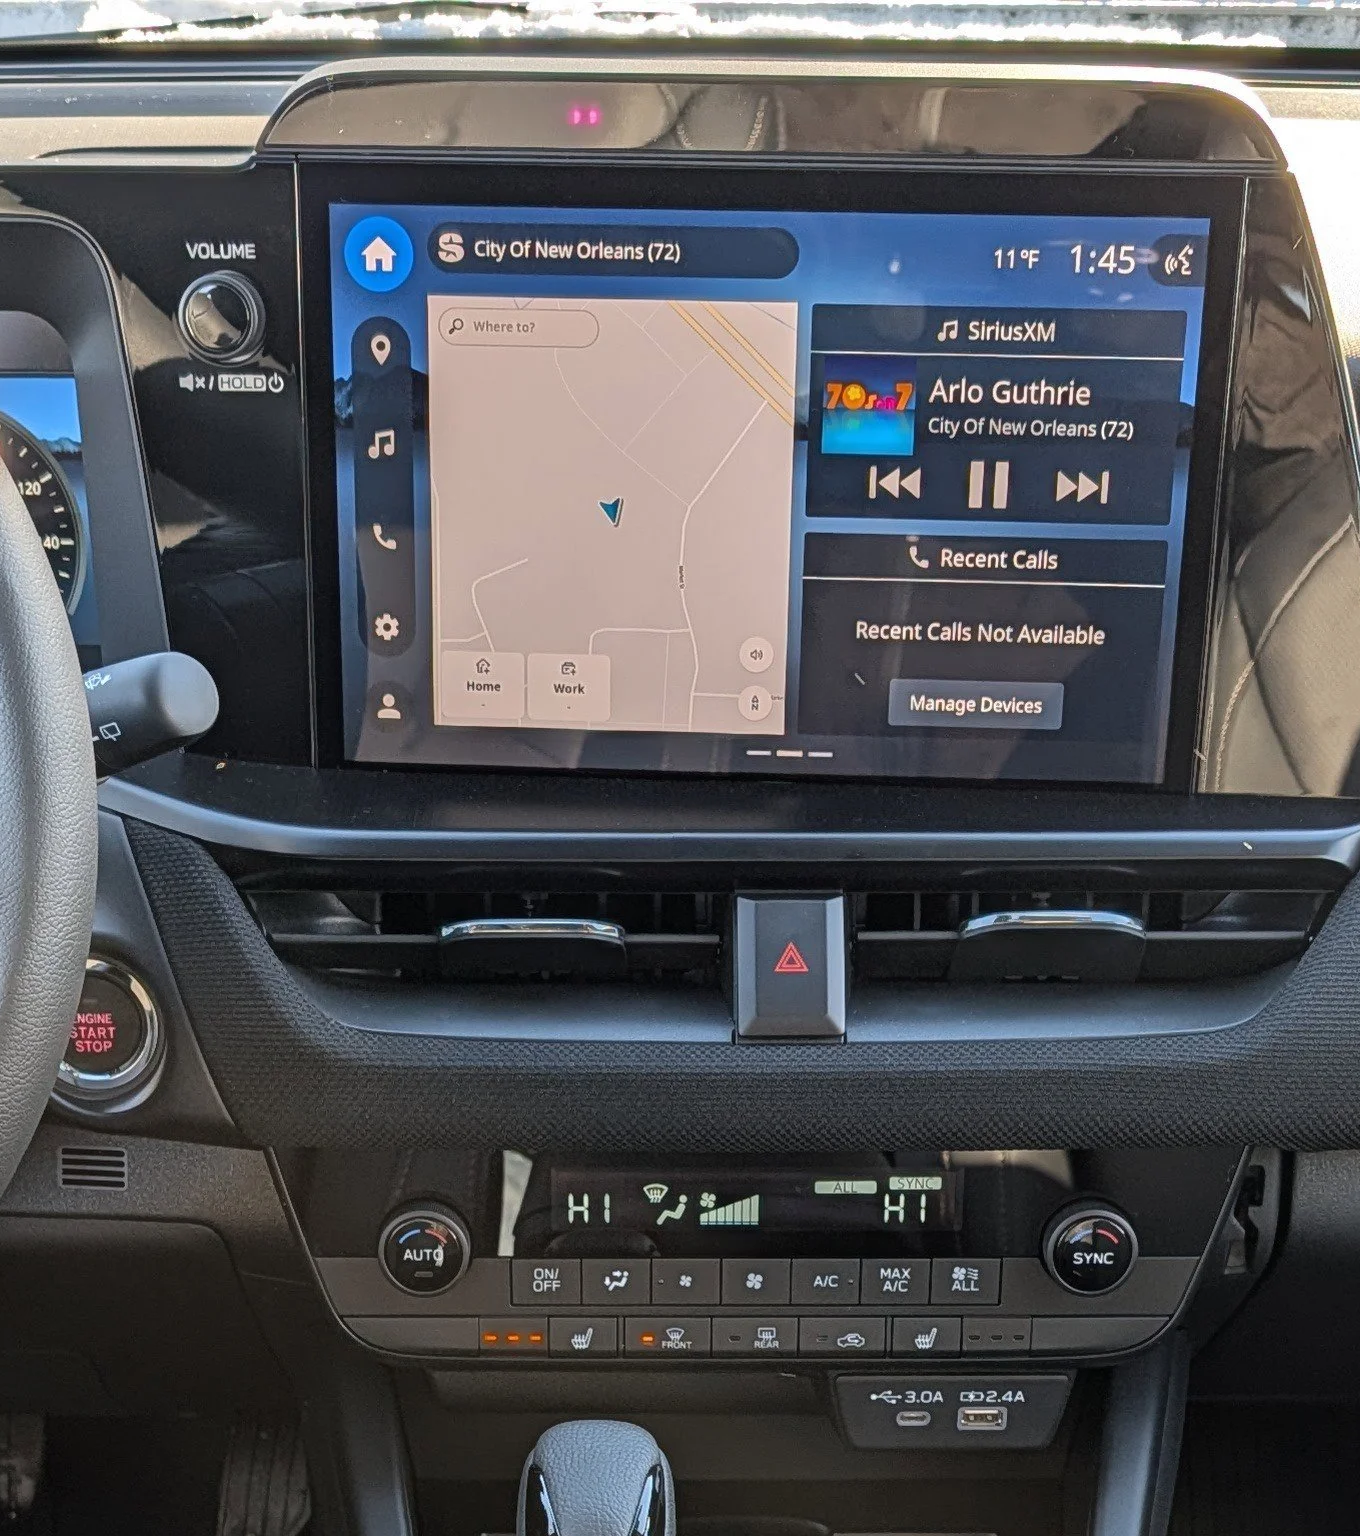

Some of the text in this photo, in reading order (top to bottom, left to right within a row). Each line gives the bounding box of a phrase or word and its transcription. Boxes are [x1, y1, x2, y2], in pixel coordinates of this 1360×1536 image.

[186, 242, 256, 259] VOLUME
[474, 241, 681, 263] City Of New Orleans (72)
[1071, 244, 1136, 274] 1:45
[473, 320, 536, 334] Where to?
[968, 321, 1056, 342] SiriusXM
[220, 377, 264, 389] HOLD
[895, 382, 912, 410] 7
[928, 378, 1091, 406] Arlo Guthrie
[928, 417, 1134, 440] City Of New Orleans (72)
[18, 480, 41, 496] 120
[940, 548, 1058, 570] Recent Calls
[856, 620, 1106, 645] Recent Calls Not Available
[466, 681, 501, 692] Home
[553, 683, 585, 694] Work
[910, 695, 1043, 716] Manage Devices
[74, 1013, 112, 1024] NGINE
[75, 1041, 112, 1053] STOP
[832, 1182, 858, 1193] ALL
[897, 1177, 934, 1190] SYNC
[403, 1248, 444, 1261] AUTO
[1072, 1252, 1114, 1266] SYNC
[533, 1267, 559, 1280] ON/
[880, 1267, 911, 1280] MAX
[533, 1280, 561, 1293] OFF
[813, 1275, 839, 1288] A/C
[883, 1280, 909, 1292] A/C
[951, 1280, 979, 1291] ALL
[661, 1341, 692, 1350] FRONT
[754, 1339, 779, 1349] REAR
[904, 1391, 944, 1403] 3.0A
[986, 1391, 1025, 1403] 2.4A
